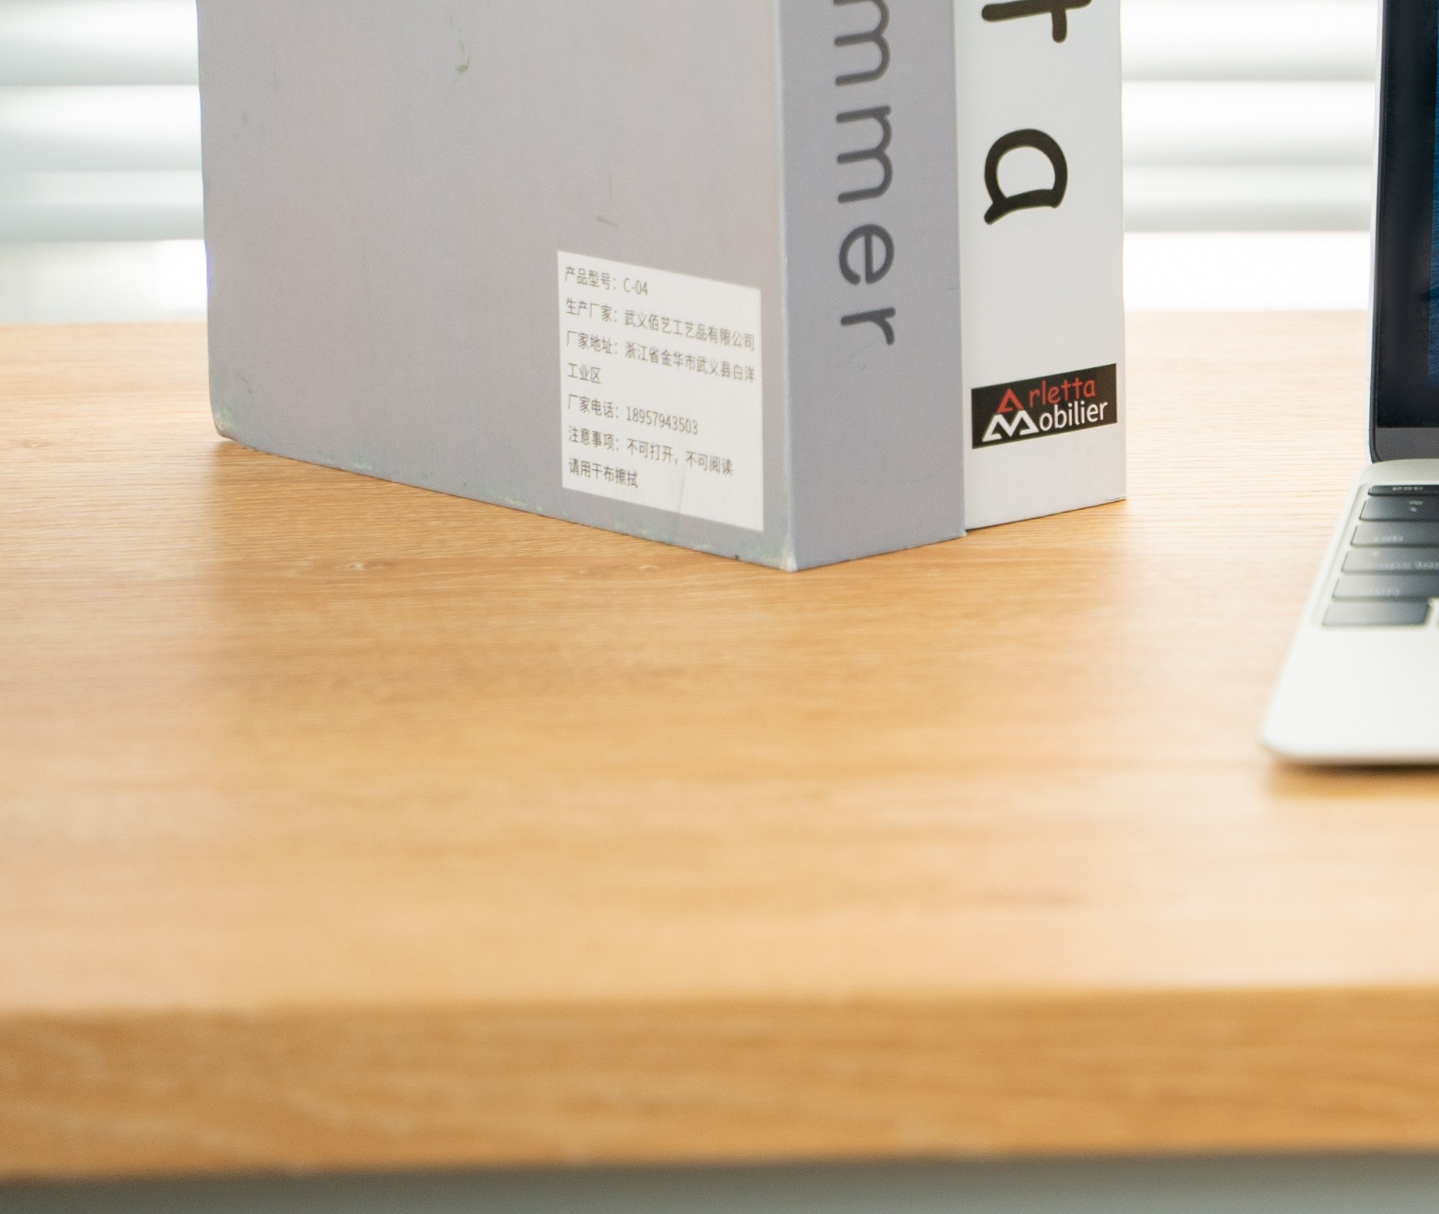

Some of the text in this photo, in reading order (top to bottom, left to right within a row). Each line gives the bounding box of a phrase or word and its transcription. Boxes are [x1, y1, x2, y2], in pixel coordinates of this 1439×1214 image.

[567, 362, 602, 385] 工业区
[996, 376, 1096, 414] Arletta
[982, 400, 1108, 443] Mobilier
